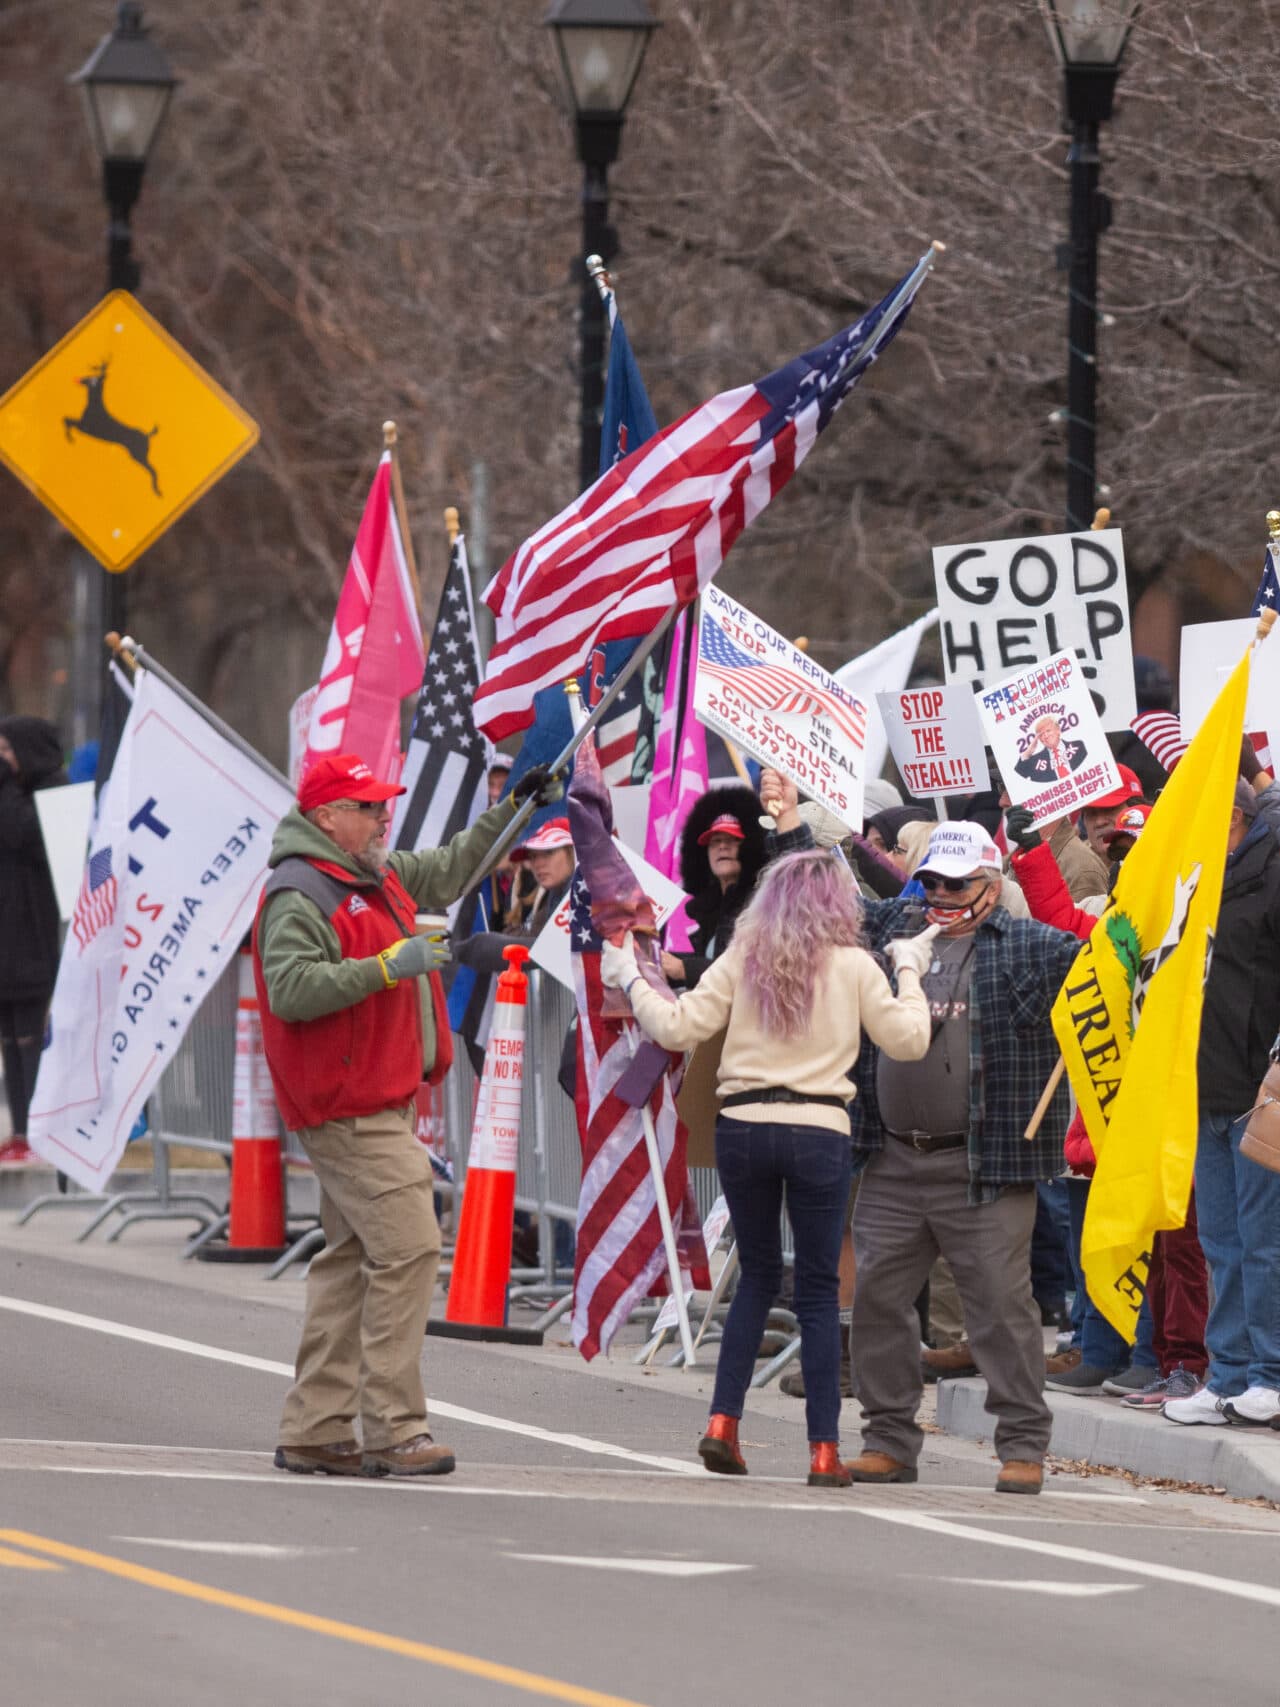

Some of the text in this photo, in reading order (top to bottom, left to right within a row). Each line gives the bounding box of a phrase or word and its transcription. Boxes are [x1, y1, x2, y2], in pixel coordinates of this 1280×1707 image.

[945, 538, 1118, 606] GOD
[721, 616, 767, 655] STOP
[945, 600, 1123, 673] HELP
[709, 589, 865, 717] SAVE OUR REPUBLIC
[900, 690, 945, 721] STOP
[983, 657, 1073, 723] TRUMP
[1027, 695, 1042, 708] 2020
[810, 717, 832, 738] THE
[1019, 702, 1066, 733] AMERICA
[721, 685, 758, 723] CALL
[762, 716, 837, 784] SCOTUS:
[912, 727, 945, 755] THE
[809, 731, 859, 779] STEAL
[1035, 742, 1079, 771] IS BACK
[903, 759, 974, 791] STEAL!!!
[1021, 780, 1073, 810] PROMISES
[1074, 764, 1103, 785] MADE
[1032, 789, 1078, 820] ROMISES
[1079, 777, 1105, 798] KEPT
[938, 831, 973, 843] AMERICA
[941, 845, 966, 856] AGAIN
[493, 1039, 525, 1057] TEMP
[1066, 970, 1123, 1127] TREA
[493, 1061, 509, 1080] NO
